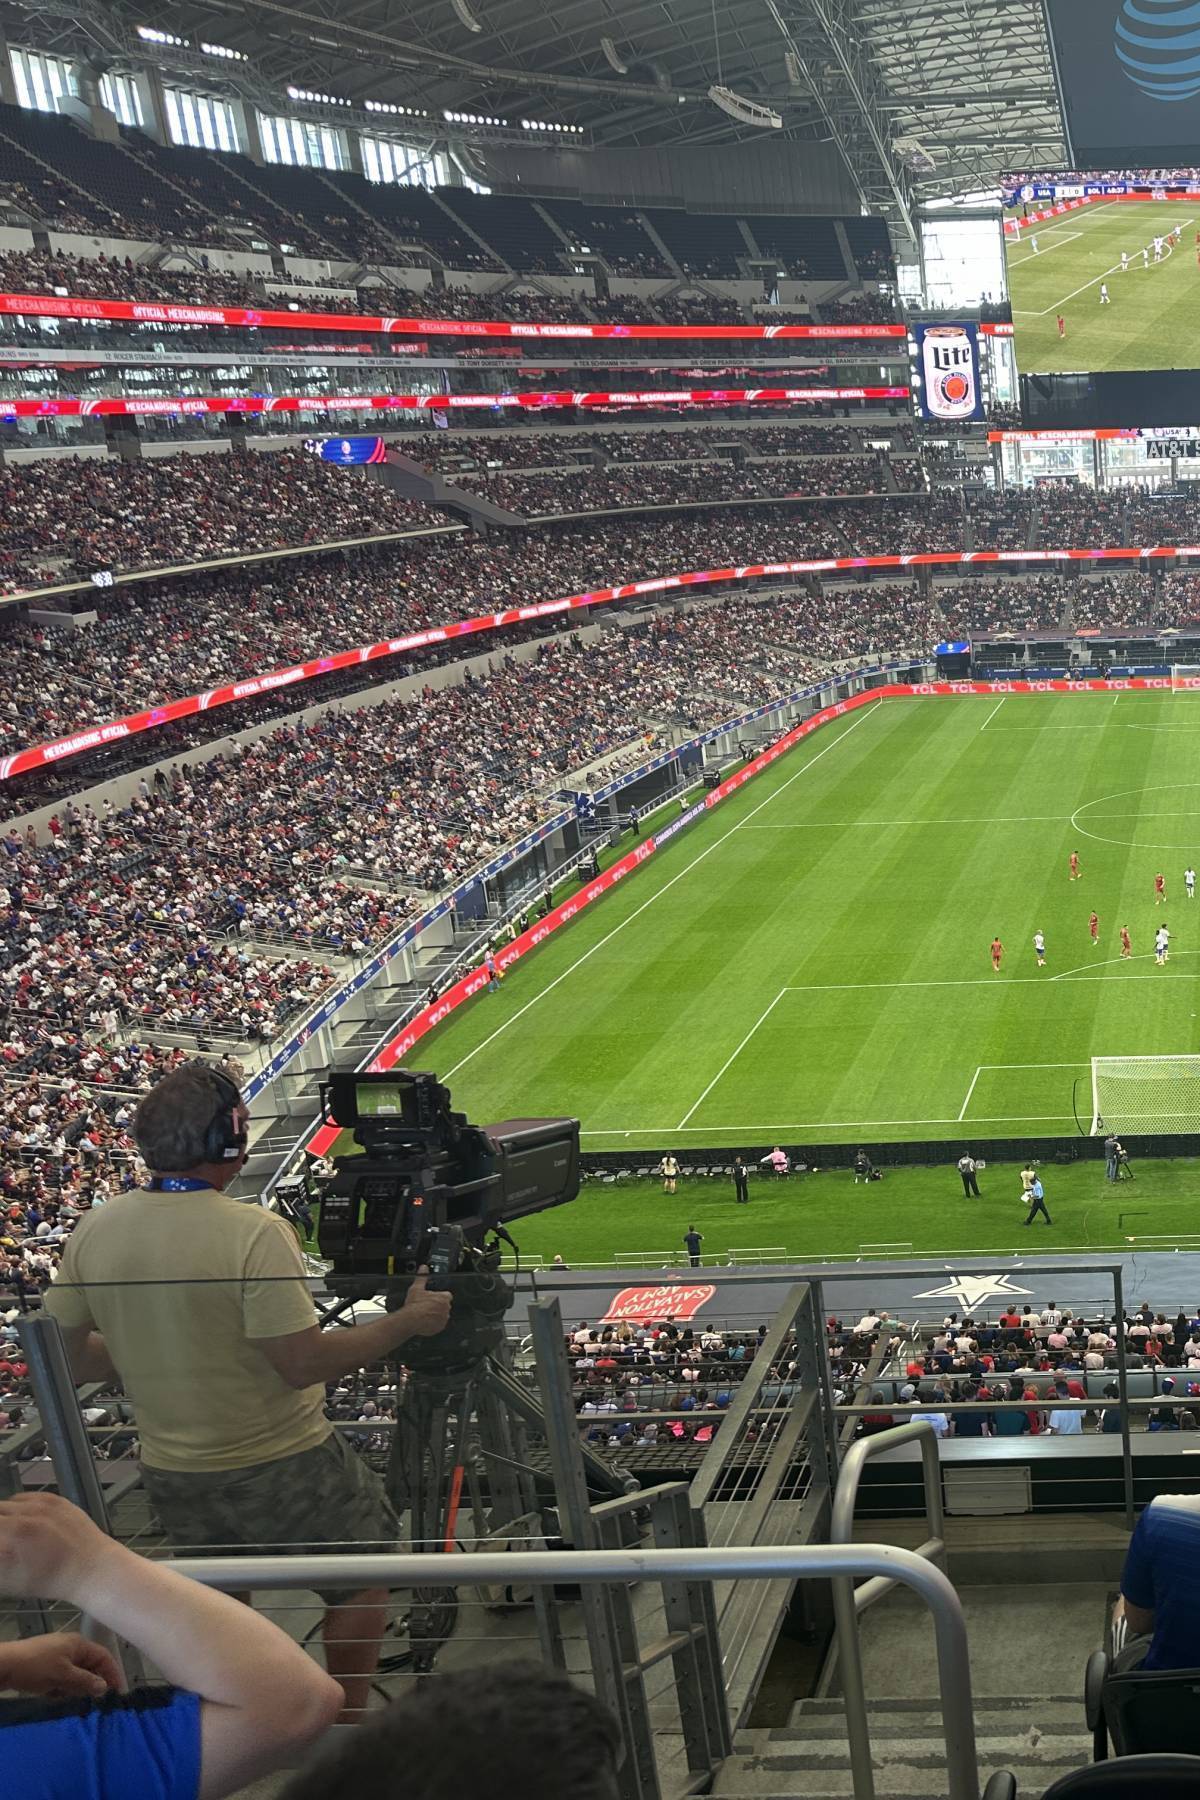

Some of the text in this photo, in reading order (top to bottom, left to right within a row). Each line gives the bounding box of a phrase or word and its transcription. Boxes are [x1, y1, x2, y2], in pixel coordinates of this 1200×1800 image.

[1151, 192, 1168, 200] TCL
[133, 305, 226, 323] OFFICIAL MERCHANDISING
[510, 325, 593, 336] OFFICIAL MERCHANDISING
[932, 346, 970, 371] Lite
[609, 391, 692, 403] OFFICIAL MERCHANDISING
[786, 389, 866, 399] MERCHANDISING OFICIAL
[125, 401, 209, 412] MERCHANDISING OFICIAL
[298, 398, 373, 409] OFFICIAL MERCHANDISING
[1002, 431, 1096, 440] OFFICIAL MERCHANDISING
[1147, 441, 1191, 458] AT&T
[233, 668, 304, 696] OFFICIAL MERCHANDISING
[1027, 682, 1055, 692] TCL
[1067, 681, 1094, 691] TCL
[1105, 680, 1132, 689] TCL
[1144, 679, 1172, 688] TCL
[911, 685, 939, 695] TCL
[949, 684, 977, 694] TCL
[988, 683, 1016, 693] TCL
[43, 723, 130, 760] MERCHANDISING OFICIAL
[708, 788, 721, 805] TCL
[634, 838, 652, 863] TCL
[615, 1286, 713, 1318] SALVATION
